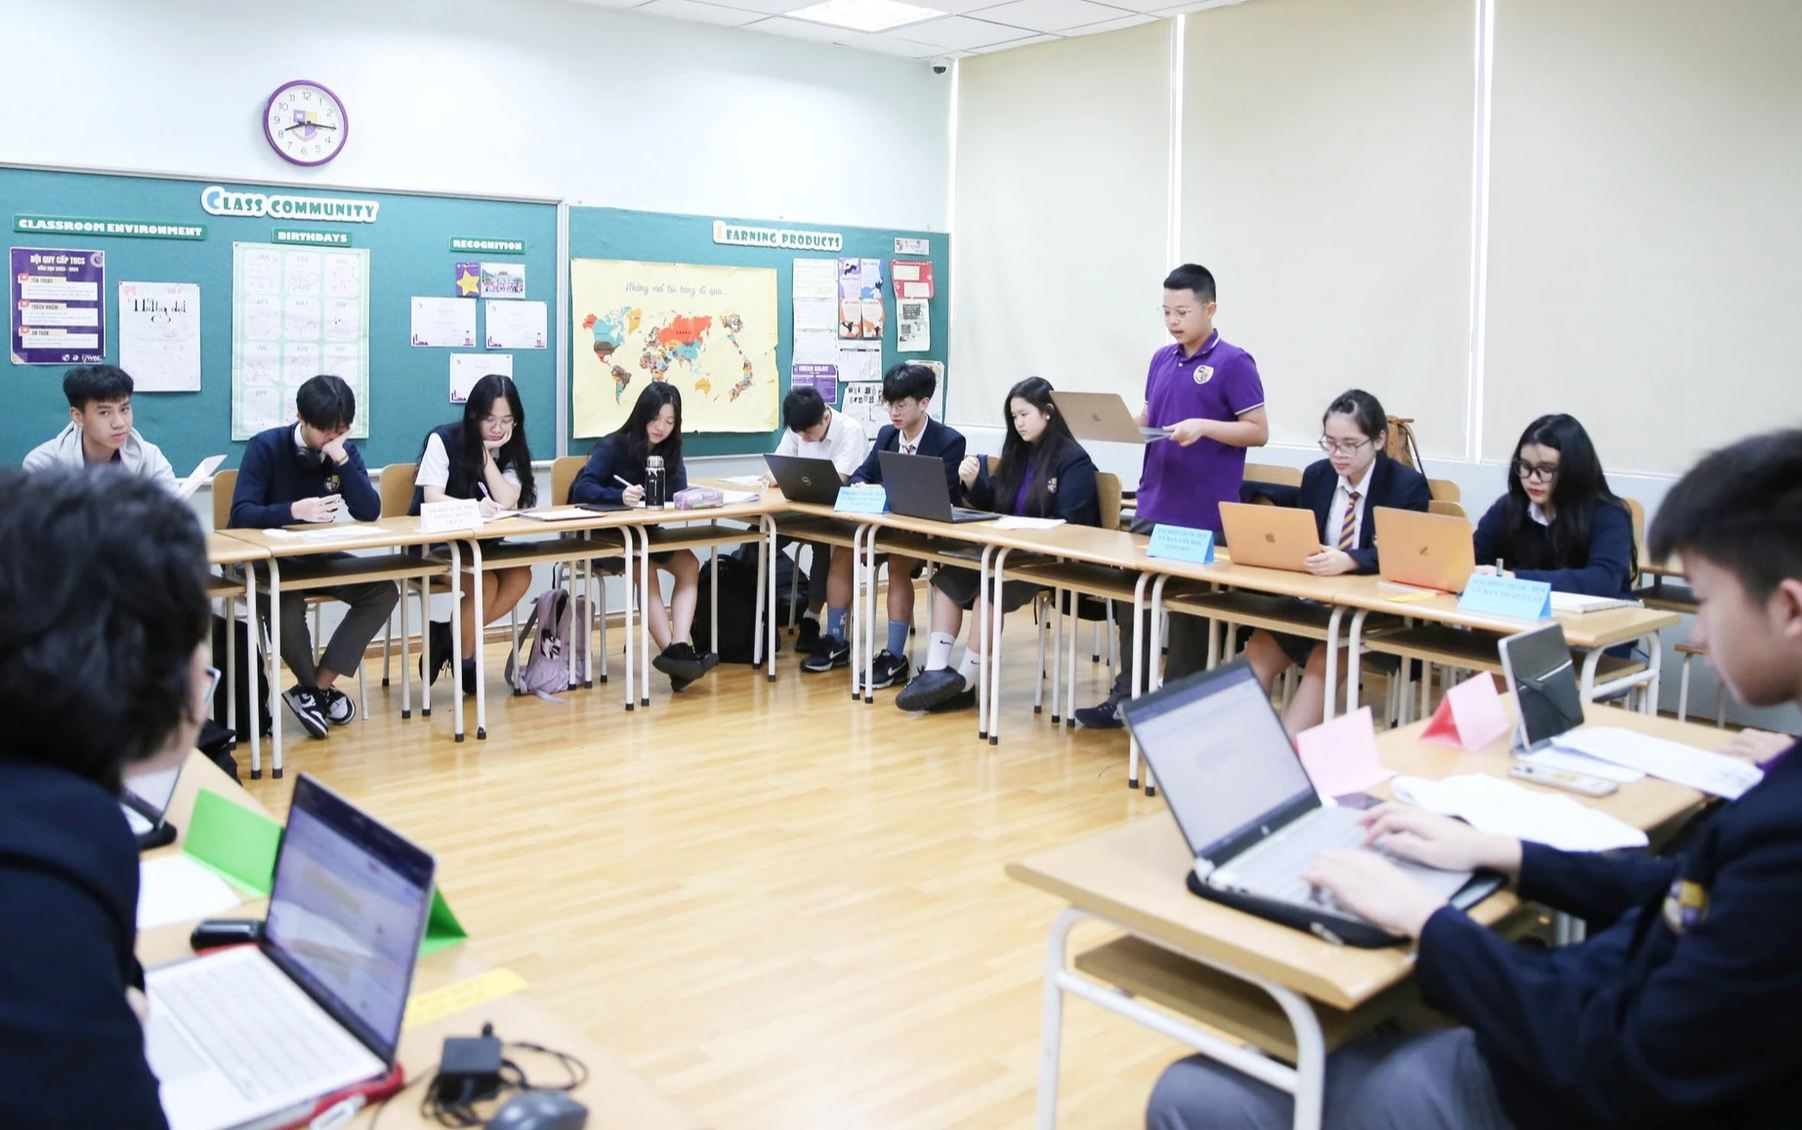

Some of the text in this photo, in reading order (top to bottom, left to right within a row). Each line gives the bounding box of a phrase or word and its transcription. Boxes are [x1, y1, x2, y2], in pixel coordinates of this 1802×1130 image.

[289, 93, 296, 102] 11
[303, 91, 312, 101] 12
[279, 102, 289, 111] 10
[319, 98, 323, 106] 1
[326, 109, 333, 117] 2
[273, 116, 281, 124] 9
[277, 130, 284, 139] 8
[324, 136, 331, 144] 4
[287, 141, 293, 149] 7
[315, 144, 321, 153] 5
[301, 146, 308, 155] 6
[206, 190, 375, 218] CLASS COMMUNITY
[18, 218, 203, 237] CLASSROOM ENVIRONMENT
[277, 231, 348, 243] BIRTHDAYS
[716, 224, 840, 248] LEARNING PRODUCTS
[453, 239, 522, 250] RECOGNITION
